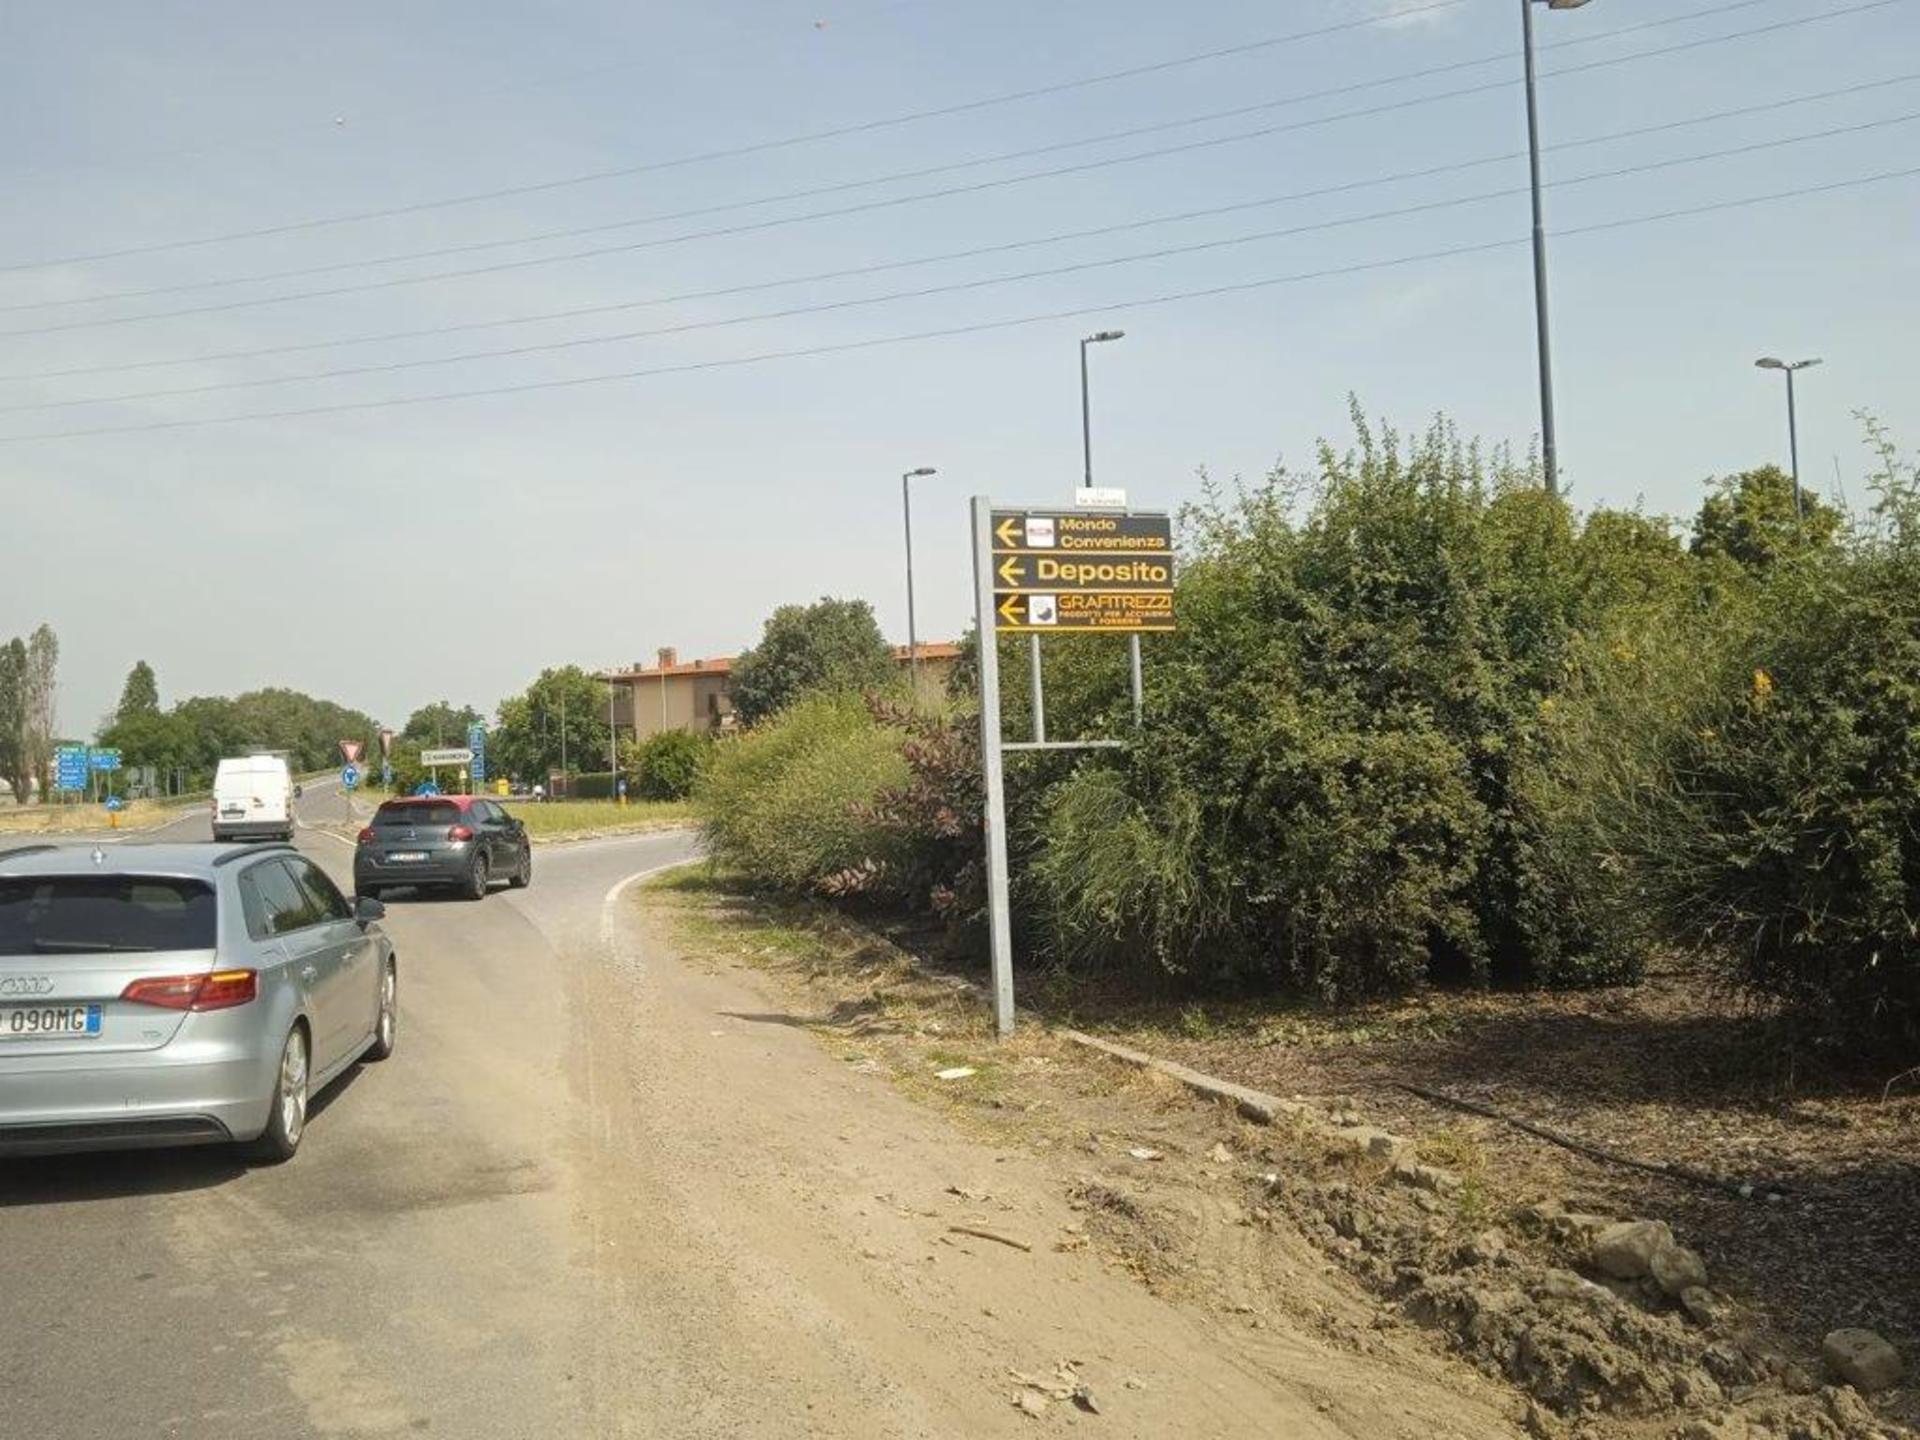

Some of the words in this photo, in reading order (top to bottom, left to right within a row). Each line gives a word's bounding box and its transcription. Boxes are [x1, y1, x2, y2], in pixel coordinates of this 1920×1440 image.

[1059, 518, 1117, 531] Mondo
[1060, 534, 1166, 549] Convenienza
[1037, 559, 1168, 585] Deposito
[11, 1008, 84, 1032] 090MG
